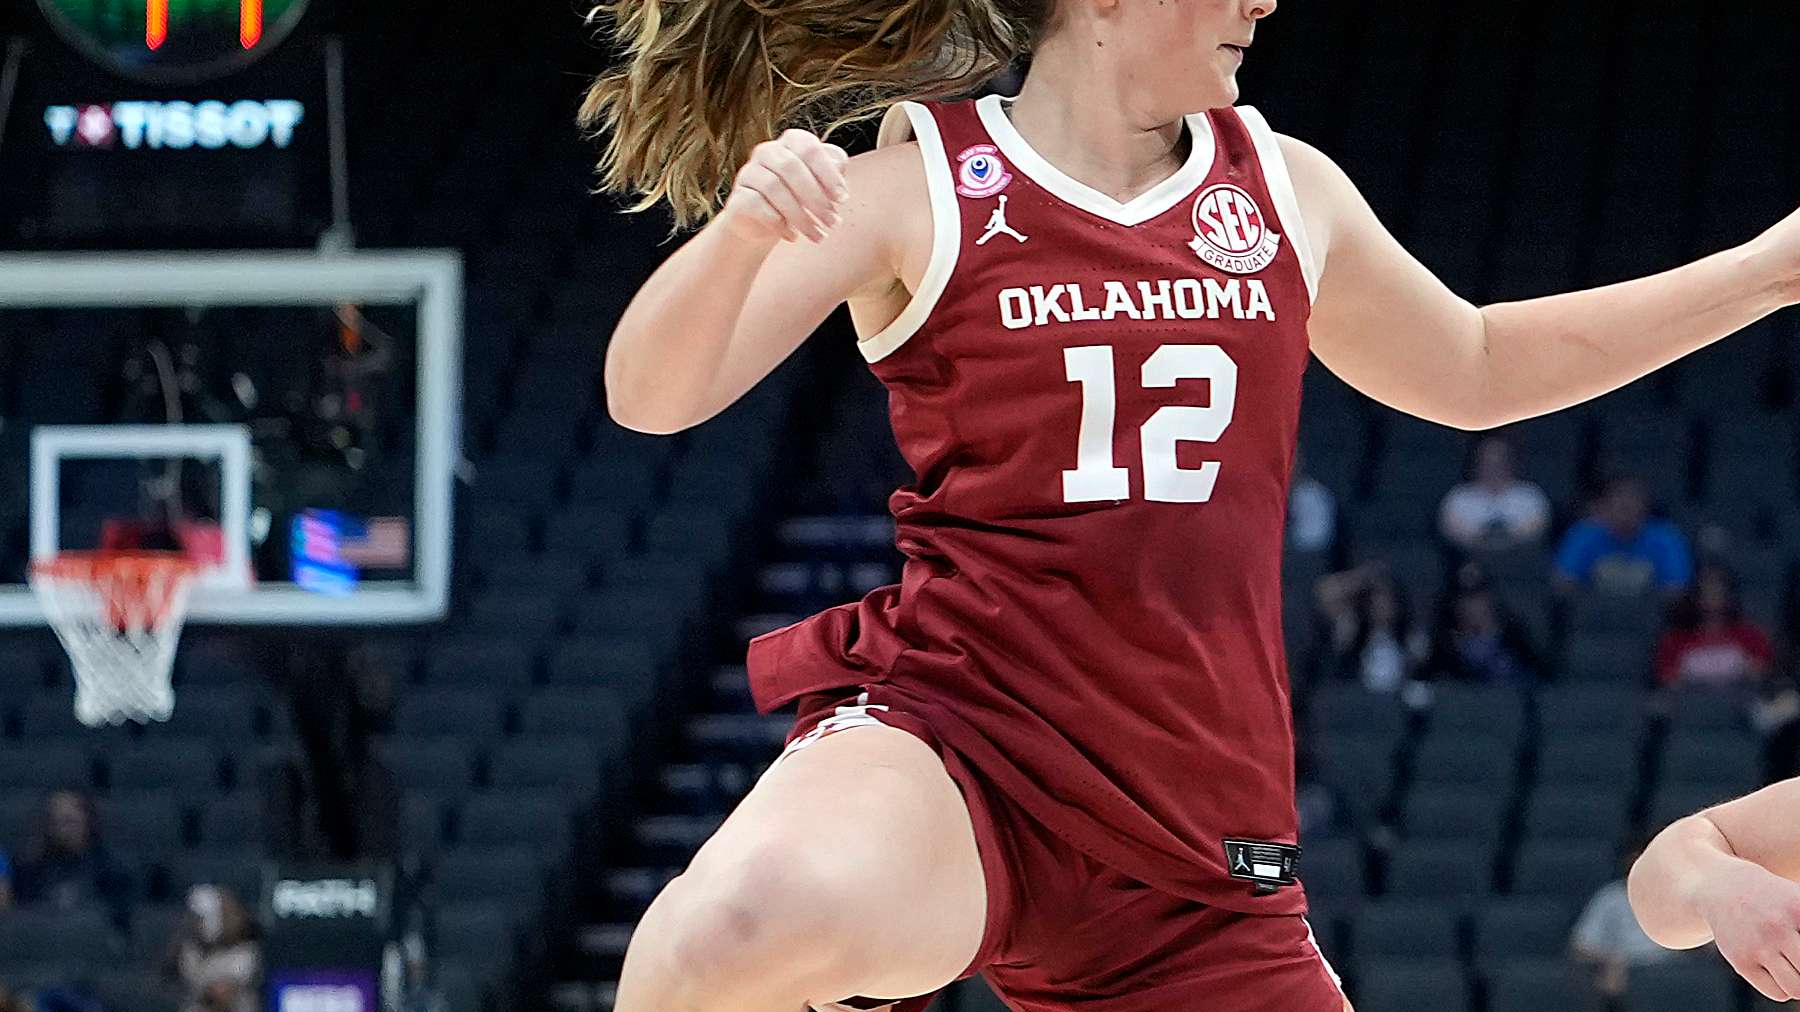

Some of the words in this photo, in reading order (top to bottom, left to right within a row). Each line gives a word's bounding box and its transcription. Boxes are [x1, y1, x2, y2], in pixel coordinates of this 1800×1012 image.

[112, 99, 304, 149] TISSOT
[1198, 189, 1260, 251] SEC
[1204, 245, 1274, 272] GRADUATE
[999, 278, 1276, 330] OKLAHOMA
[1062, 344, 1238, 503] 12
